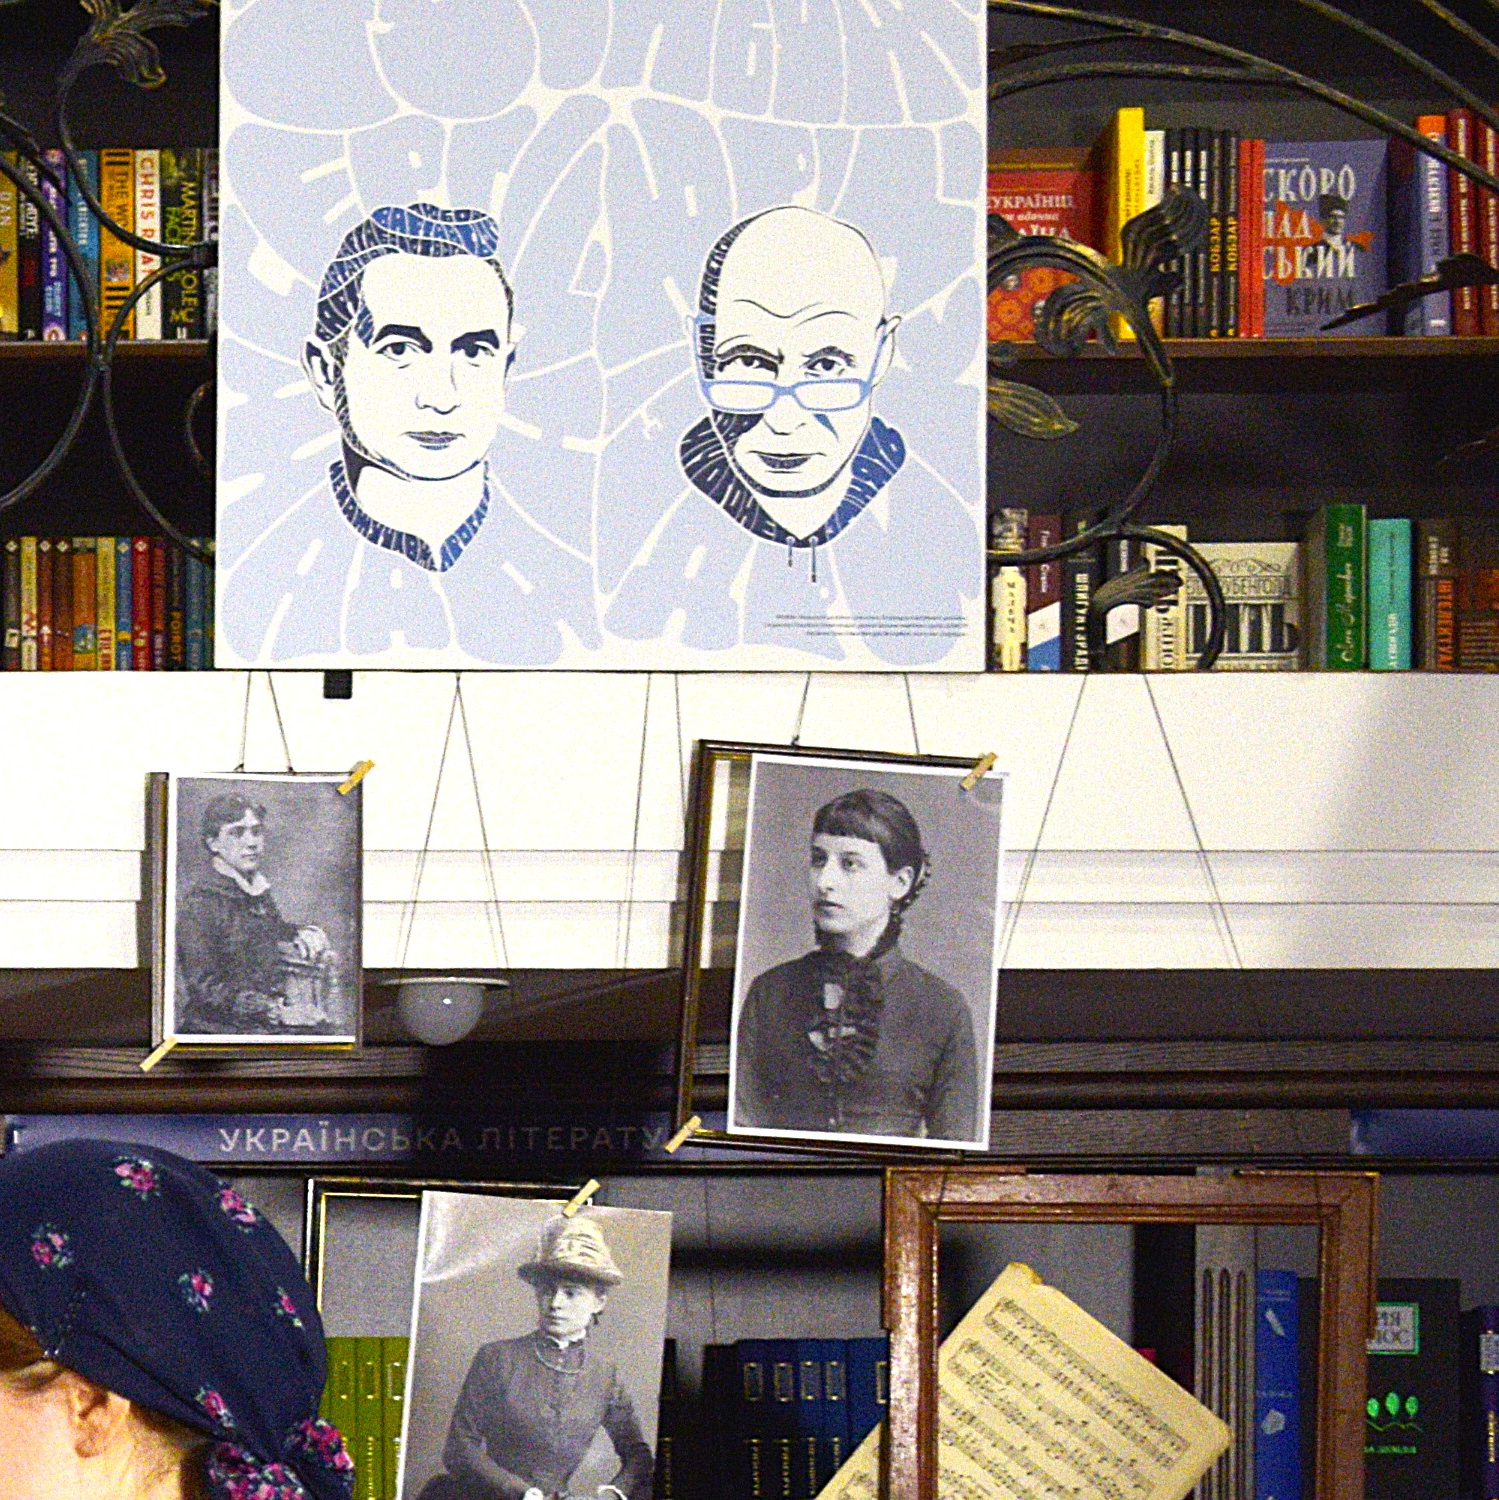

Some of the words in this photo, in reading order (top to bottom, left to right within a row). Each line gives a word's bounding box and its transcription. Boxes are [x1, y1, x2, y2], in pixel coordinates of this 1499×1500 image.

[141, 157, 155, 221] CHRIS
[1210, 217, 1221, 272] КОБЗАР
[1227, 216, 1238, 272] КОБЗАР
[218, 1119, 463, 1154] УКРАЇНСЬКА
[478, 1125, 670, 1153] ЛІТЕРАТУ
